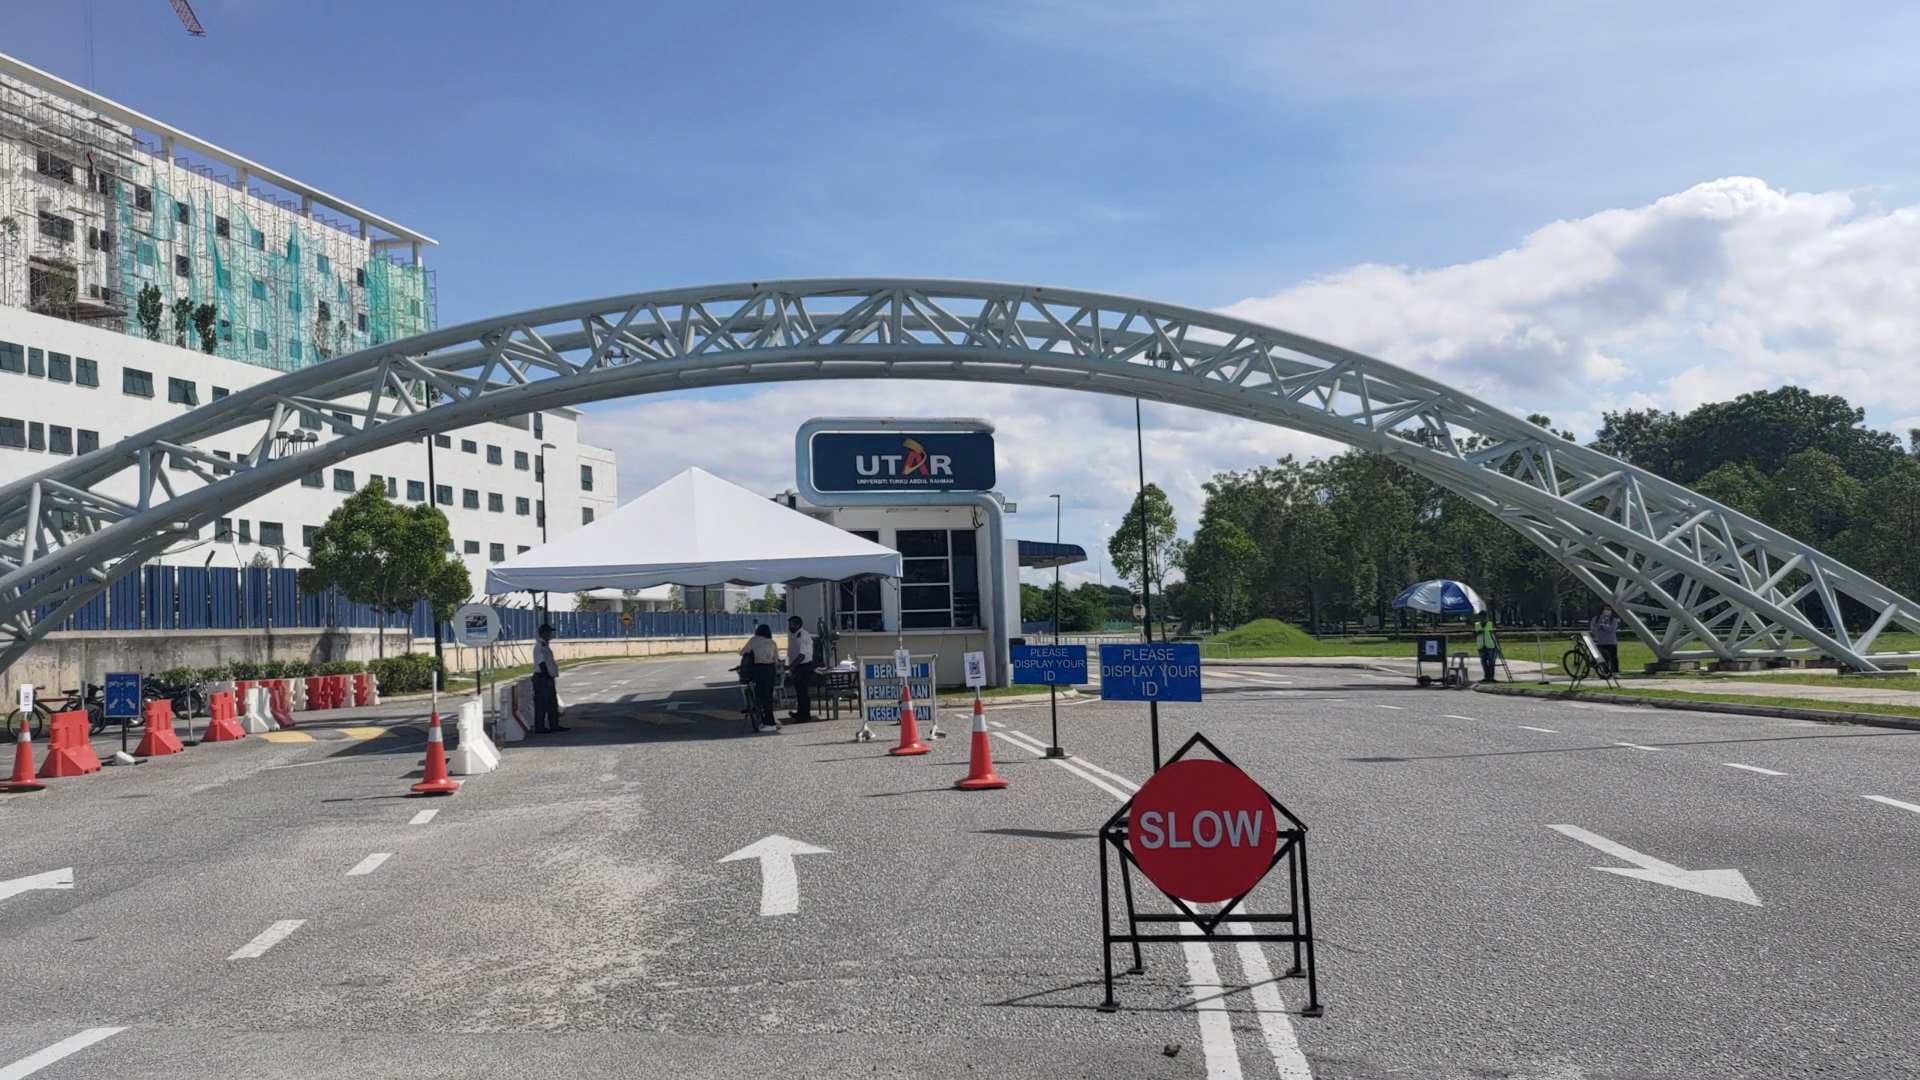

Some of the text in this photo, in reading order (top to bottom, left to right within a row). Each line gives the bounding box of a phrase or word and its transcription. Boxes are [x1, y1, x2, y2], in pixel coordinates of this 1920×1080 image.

[855, 450, 954, 476] UTAR
[1030, 648, 1069, 657] PLEASE
[1123, 648, 1176, 661] PLEASE
[873, 663, 921, 679] BERHTI
[1014, 659, 1085, 669] DISPLAY YOUR
[1102, 665, 1198, 677] DISPLAY YOUR
[1043, 670, 1056, 681] ID
[1141, 681, 1158, 697] ID
[869, 706, 929, 721] KESELATAN
[1139, 809, 1263, 849] SLOW
